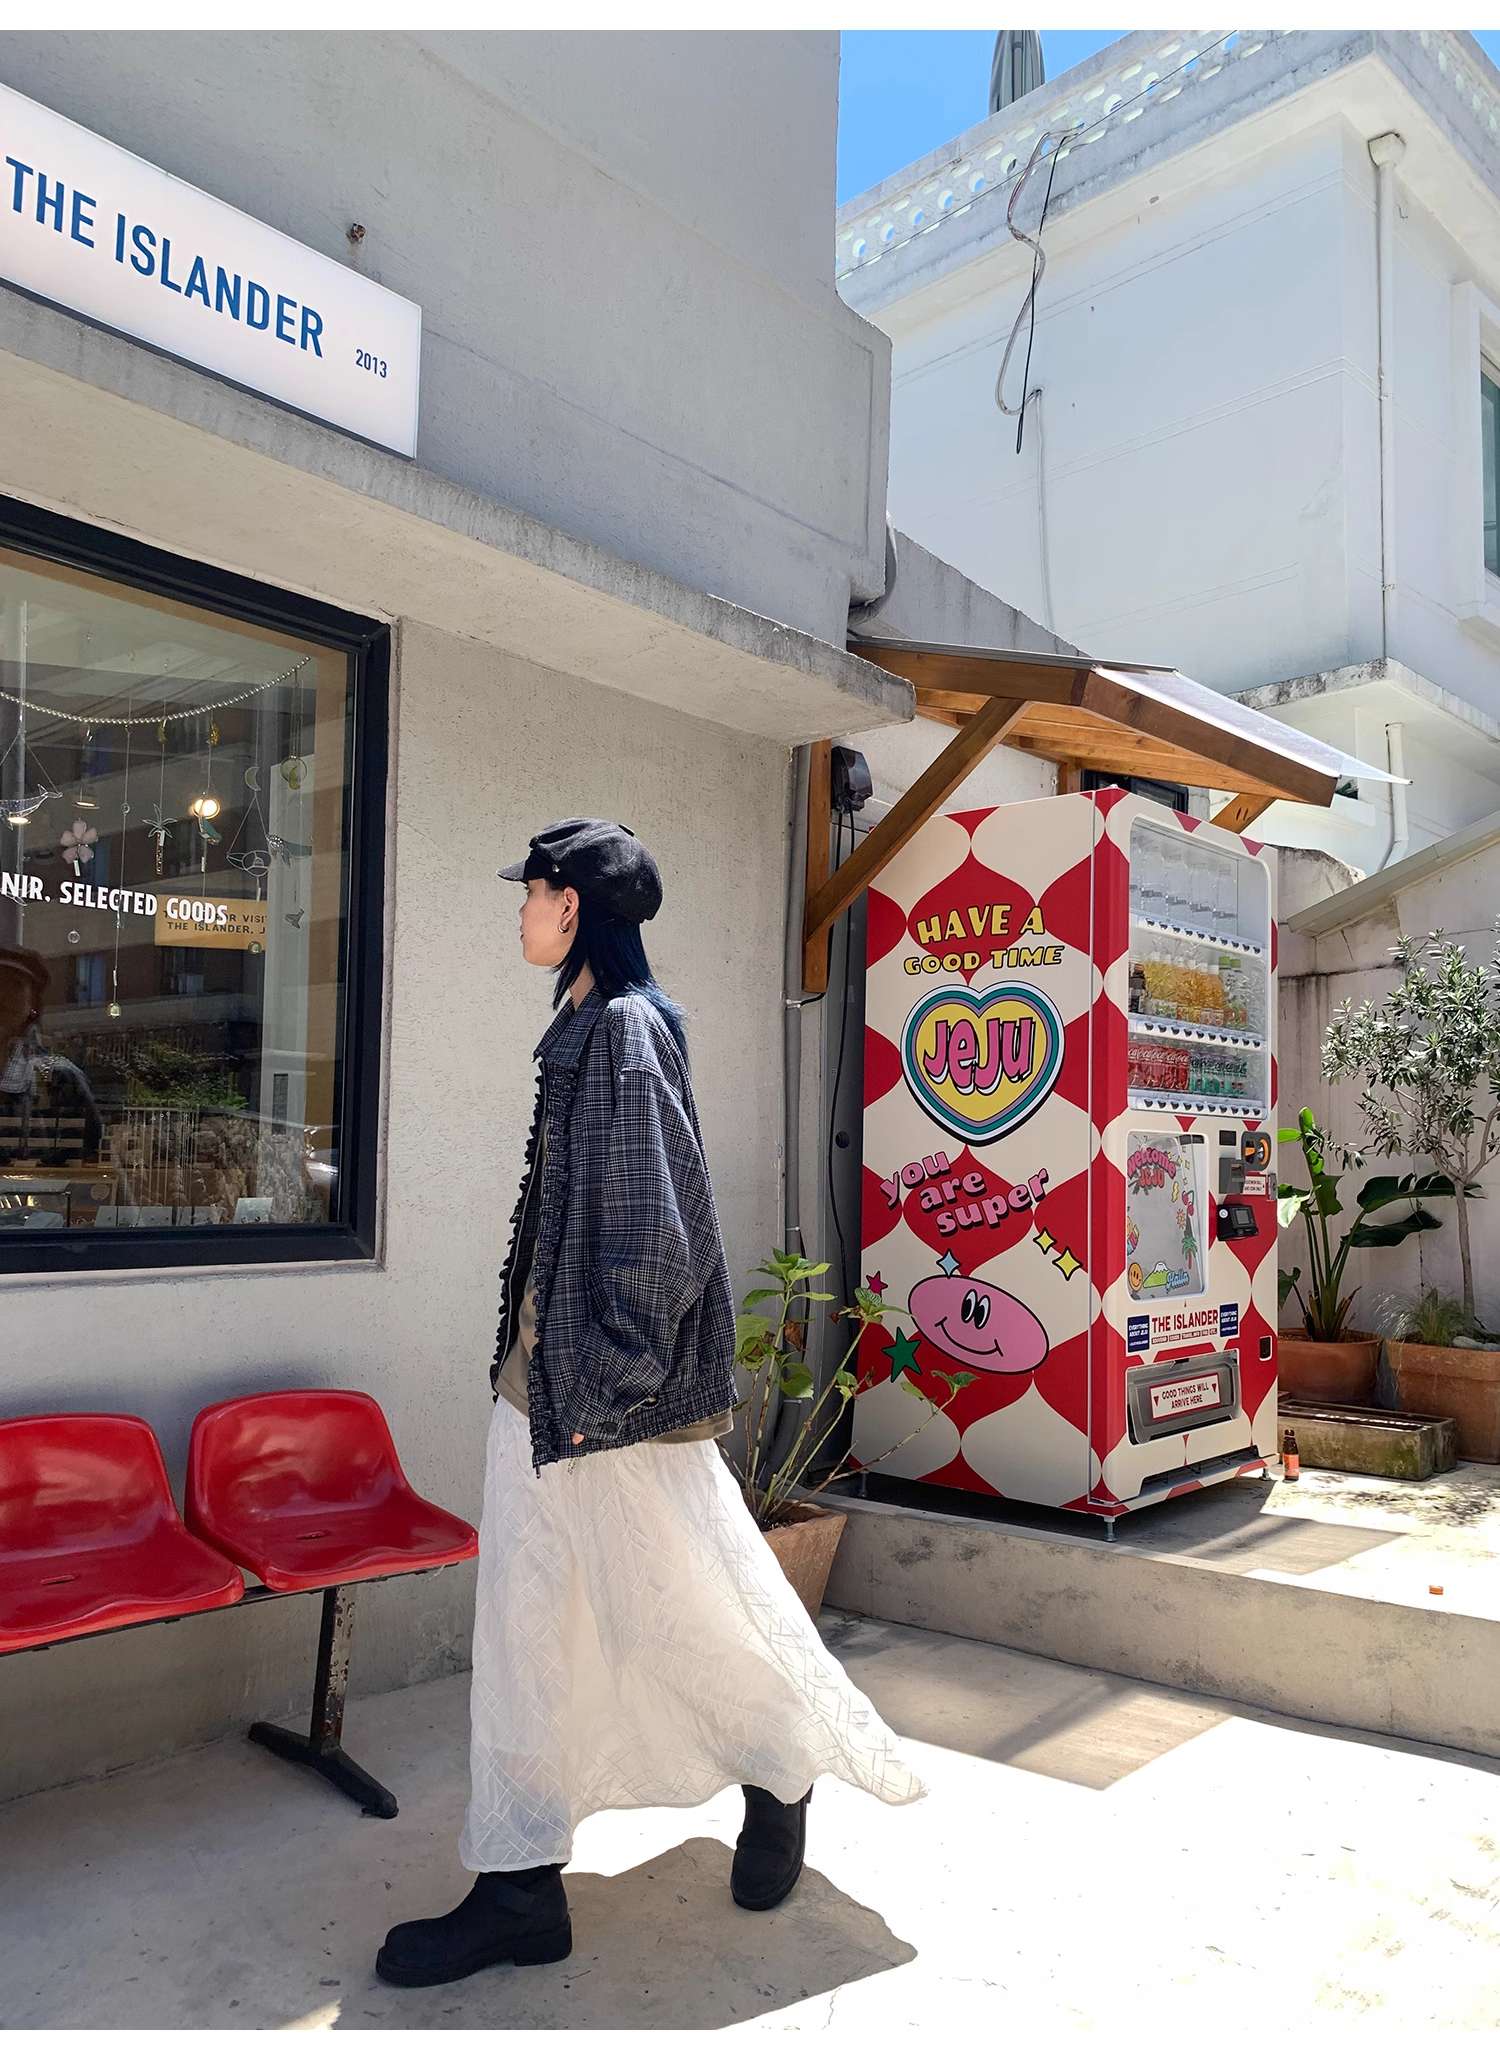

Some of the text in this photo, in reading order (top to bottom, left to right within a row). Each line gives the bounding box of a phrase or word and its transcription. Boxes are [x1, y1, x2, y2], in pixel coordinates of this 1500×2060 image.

[6, 155, 324, 359] THE ISLANDER
[355, 348, 388, 379] 2013
[59, 881, 158, 916] SELECTED
[166, 897, 228, 926] GOODS
[167, 921, 189, 931] THE
[915, 904, 1046, 945] HAVE A
[903, 945, 1065, 975] GOOD TIME
[880, 1151, 951, 1211] you
[919, 1171, 988, 1213] are
[935, 1167, 1050, 1238] super
[1151, 1309, 1218, 1333] THE ISLANDER
[1161, 1382, 1209, 1400] GOOD THINGS WILL
[1171, 1394, 1203, 1409] ARRIVE HERE
